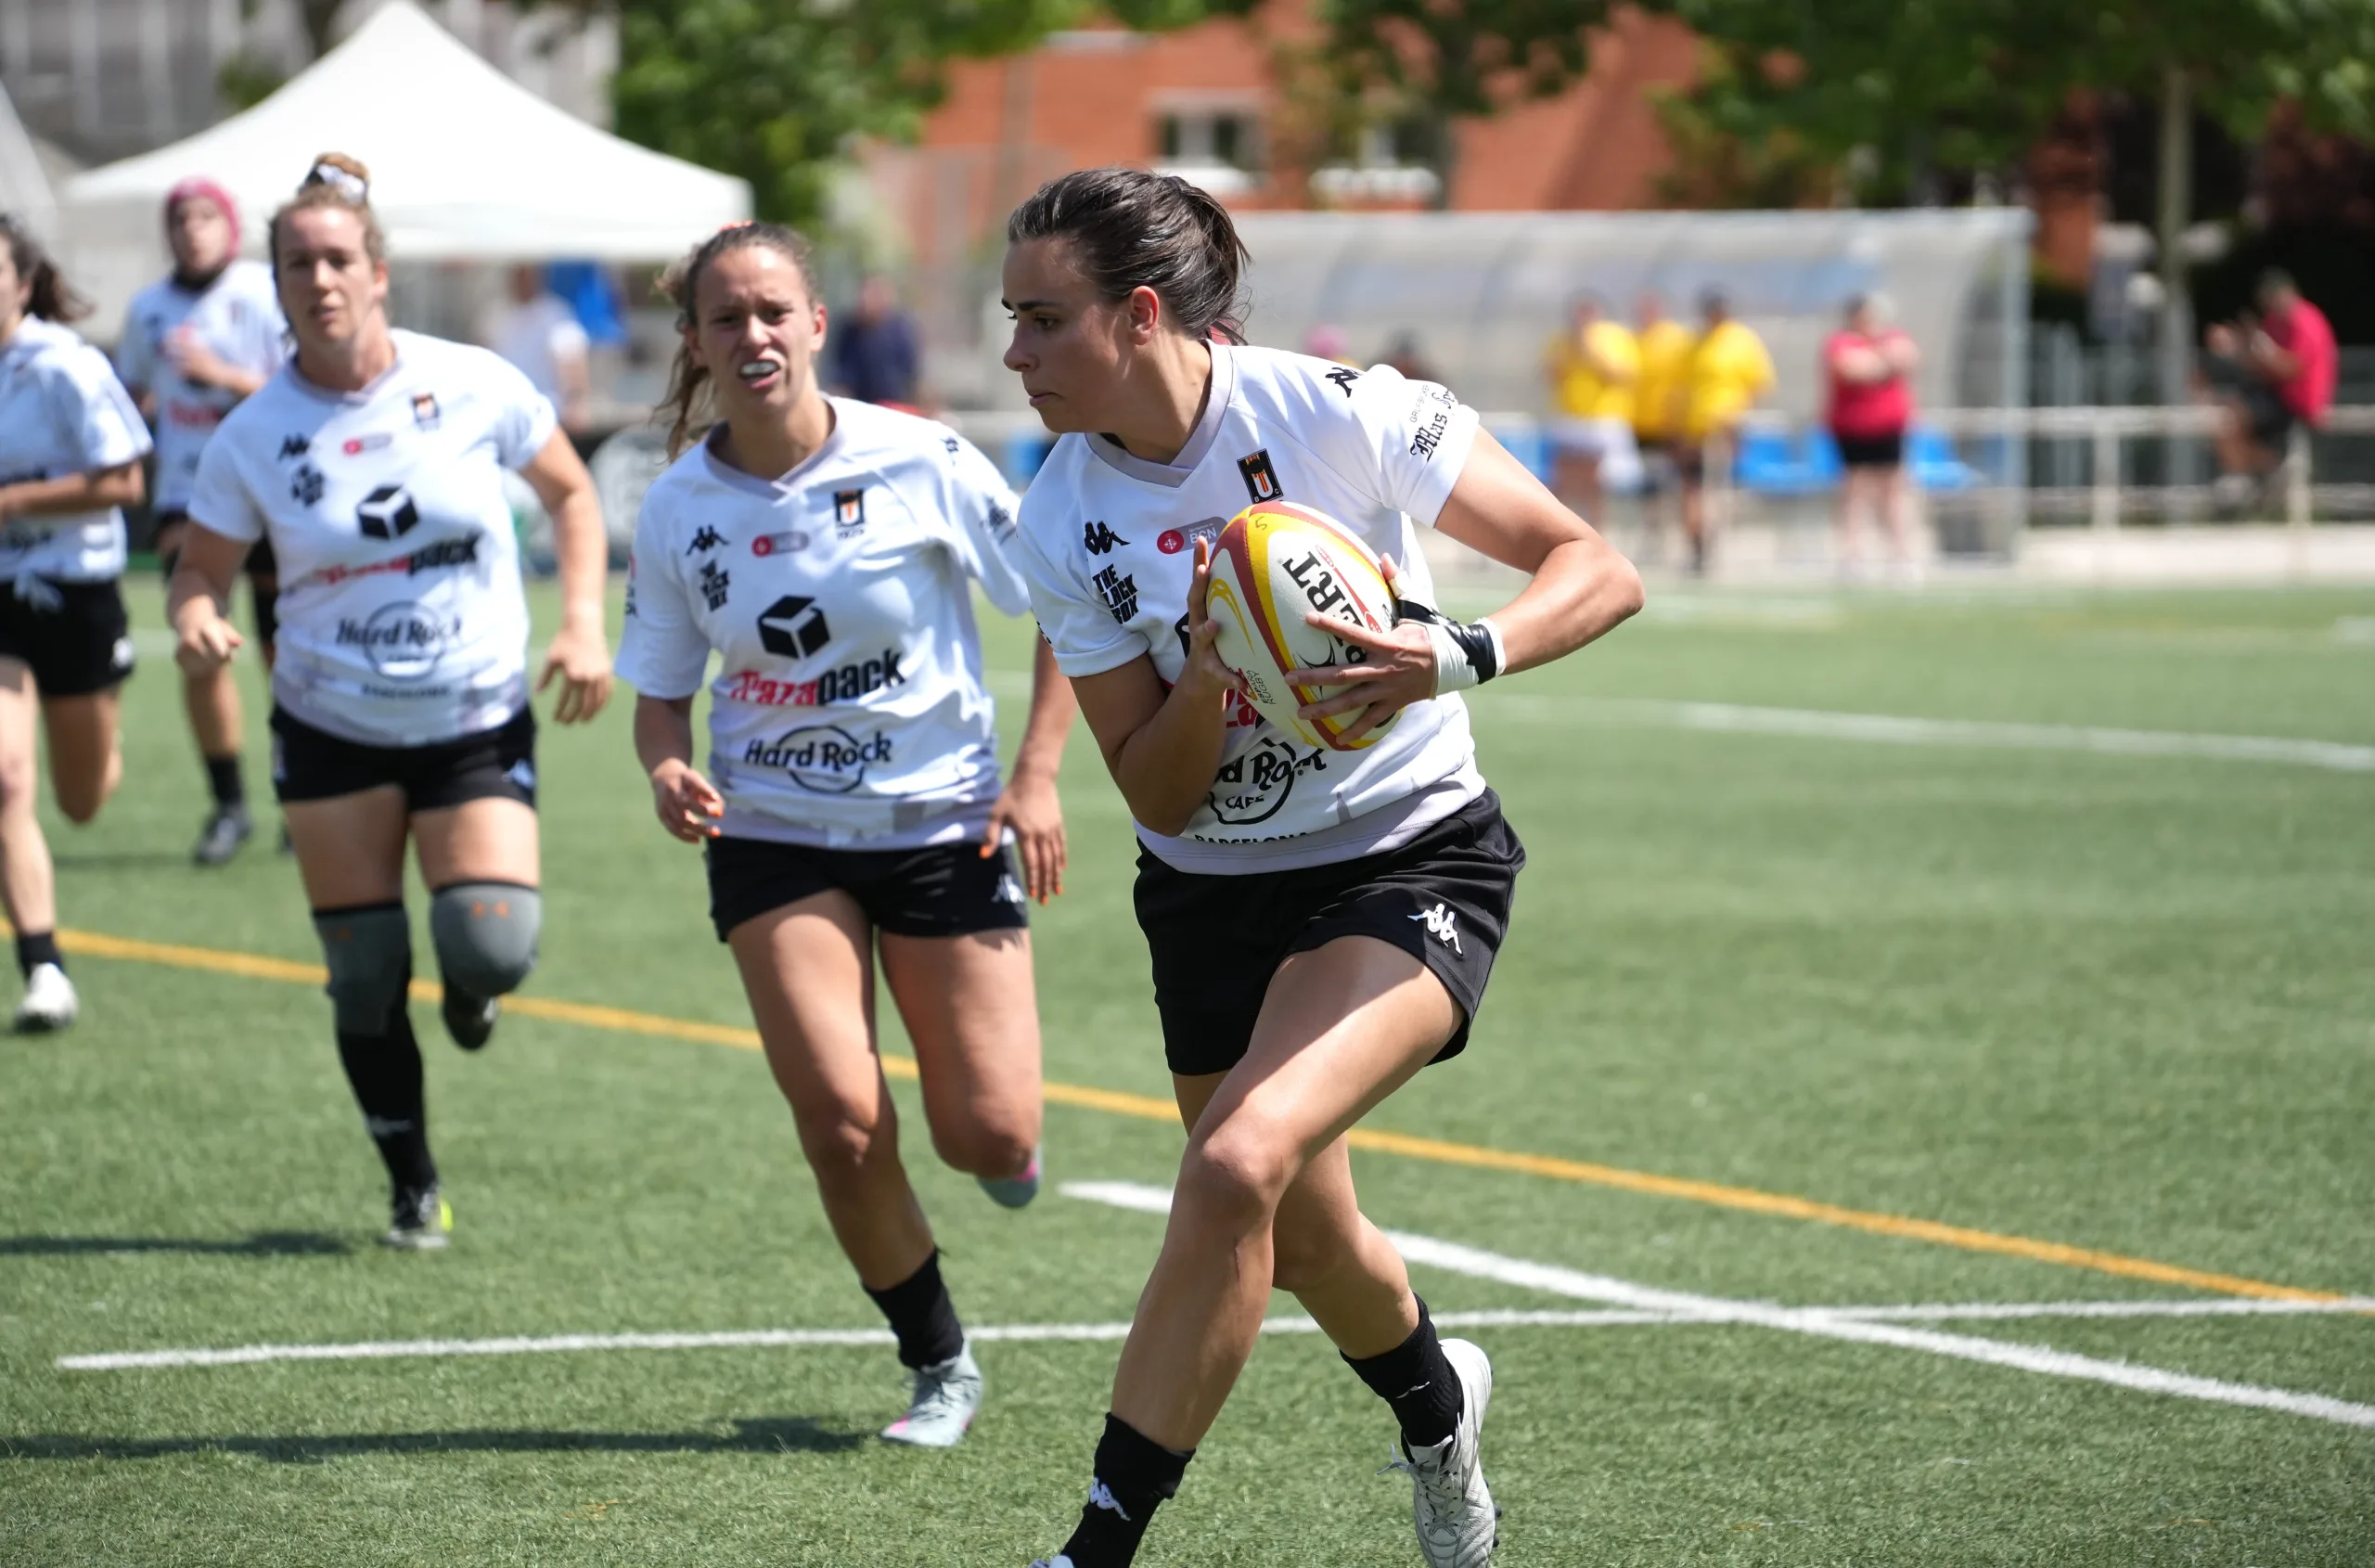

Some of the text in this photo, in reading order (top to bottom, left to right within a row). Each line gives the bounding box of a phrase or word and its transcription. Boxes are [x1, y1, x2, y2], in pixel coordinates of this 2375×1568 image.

[1189, 527, 1217, 544] BCN
[1092, 563, 1119, 592] THE
[1103, 573, 1138, 609] LACK
[1110, 595, 1139, 624] BOX
[1249, 670, 1277, 705] RUGBY
[744, 731, 892, 772] Hard Rock
